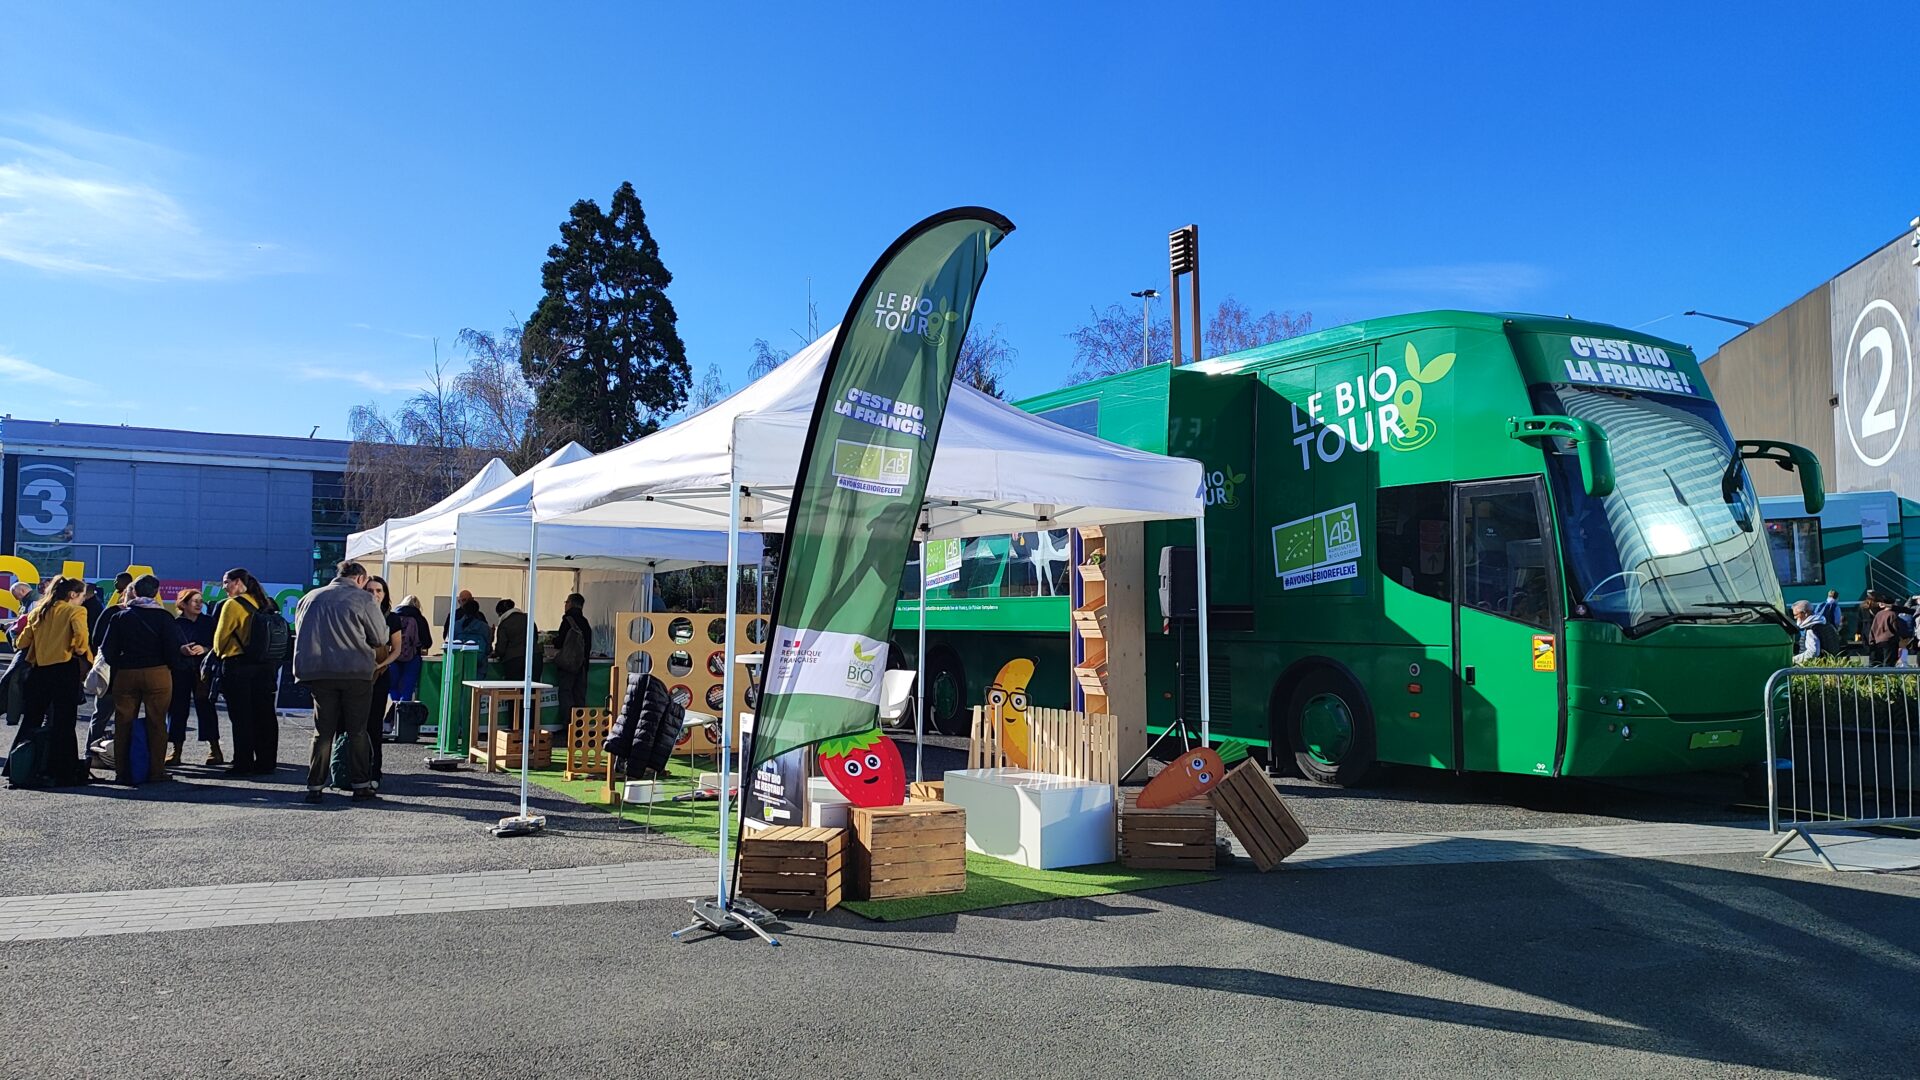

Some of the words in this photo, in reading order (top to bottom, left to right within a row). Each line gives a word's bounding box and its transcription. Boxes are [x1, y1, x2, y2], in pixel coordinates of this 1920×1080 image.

[877, 291, 897, 309] LE
[901, 294, 933, 315] BIO
[875, 309, 928, 336] TOUR
[1570, 336, 1633, 362] C'EST
[1632, 344, 1671, 368] BIO
[1564, 360, 1599, 382] LA
[1860, 327, 1896, 438] 2
[834, 399, 852, 417] LA
[847, 387, 892, 412] C'EST
[893, 401, 924, 420] BIO
[1291, 392, 1325, 434] LE
[1335, 365, 1398, 417] BIO
[1293, 403, 1406, 471] TOUR
[884, 457, 905, 473] AB
[1205, 471, 1224, 488] IO
[18, 478, 69, 536] 3
[1205, 487, 1228, 506] UR
[1329, 519, 1353, 547] AB
[1284, 564, 1357, 588] #AYONSLEBIOREFLEXE
